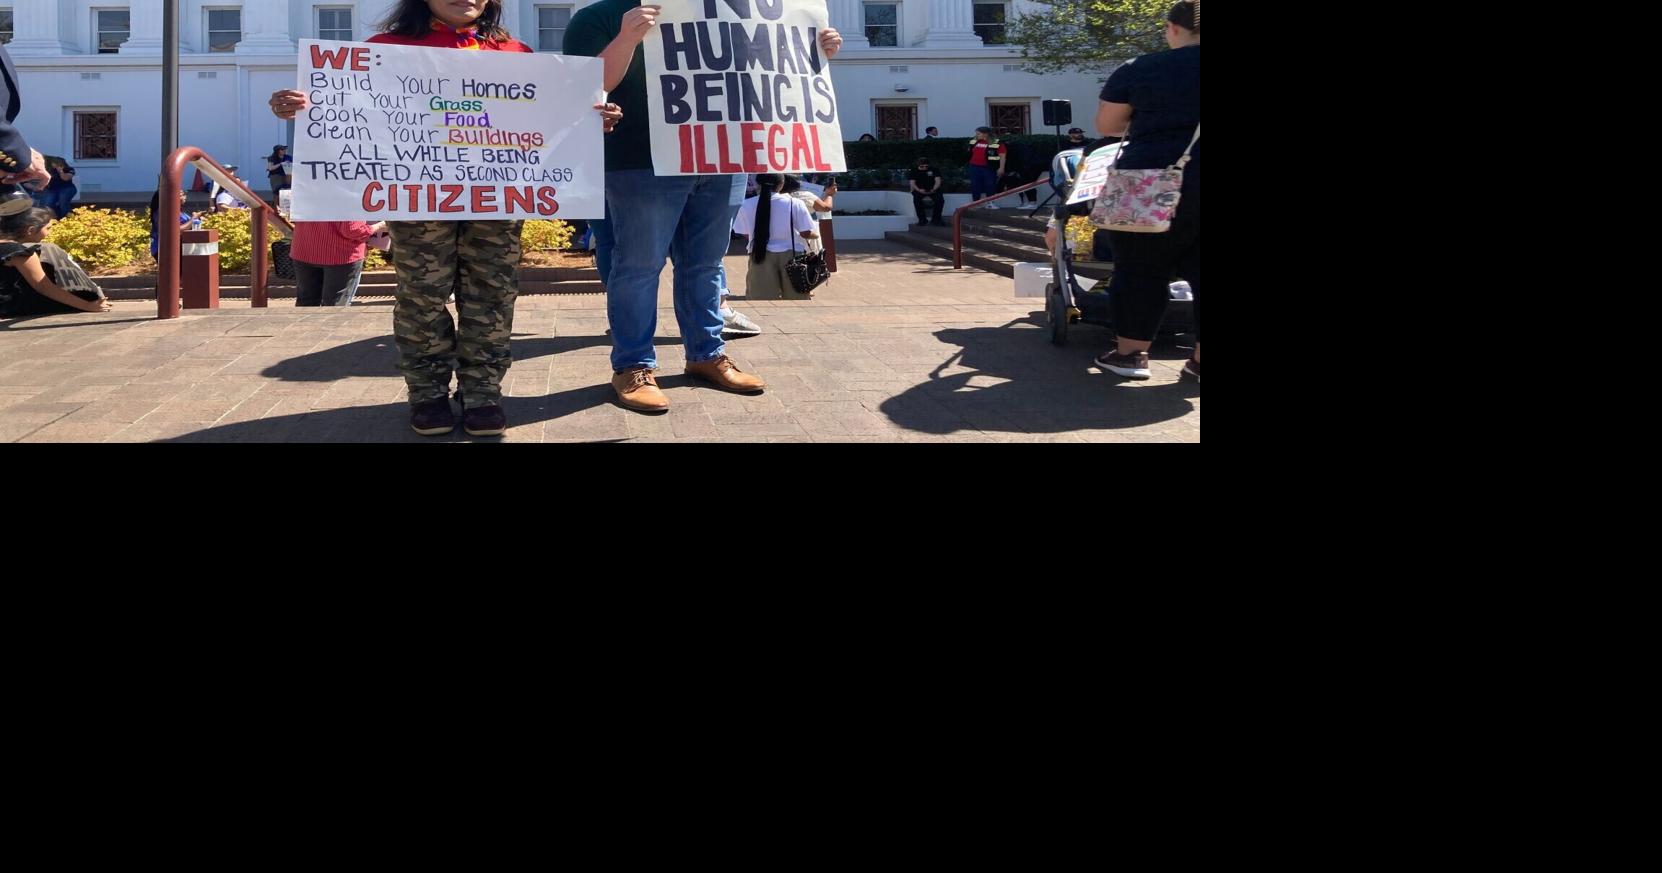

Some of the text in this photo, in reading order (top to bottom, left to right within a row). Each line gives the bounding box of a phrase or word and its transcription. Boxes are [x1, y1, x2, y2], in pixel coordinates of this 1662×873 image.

[310, 44, 382, 72] WE:
[659, 21, 822, 76] HUMAN
[310, 71, 373, 92] Build
[396, 75, 450, 95] Your
[309, 89, 487, 113] Cut Your Grass,
[659, 72, 835, 124] BEING IS
[308, 105, 493, 129] Cook Your Food,
[307, 121, 544, 152] Clean Your Buildings
[678, 122, 832, 174] ILLEGAL
[339, 143, 540, 165] ALL WHILE BEING
[300, 160, 573, 183] TREATED AS SECOND CLASS
[361, 181, 560, 216] CITIZENS
